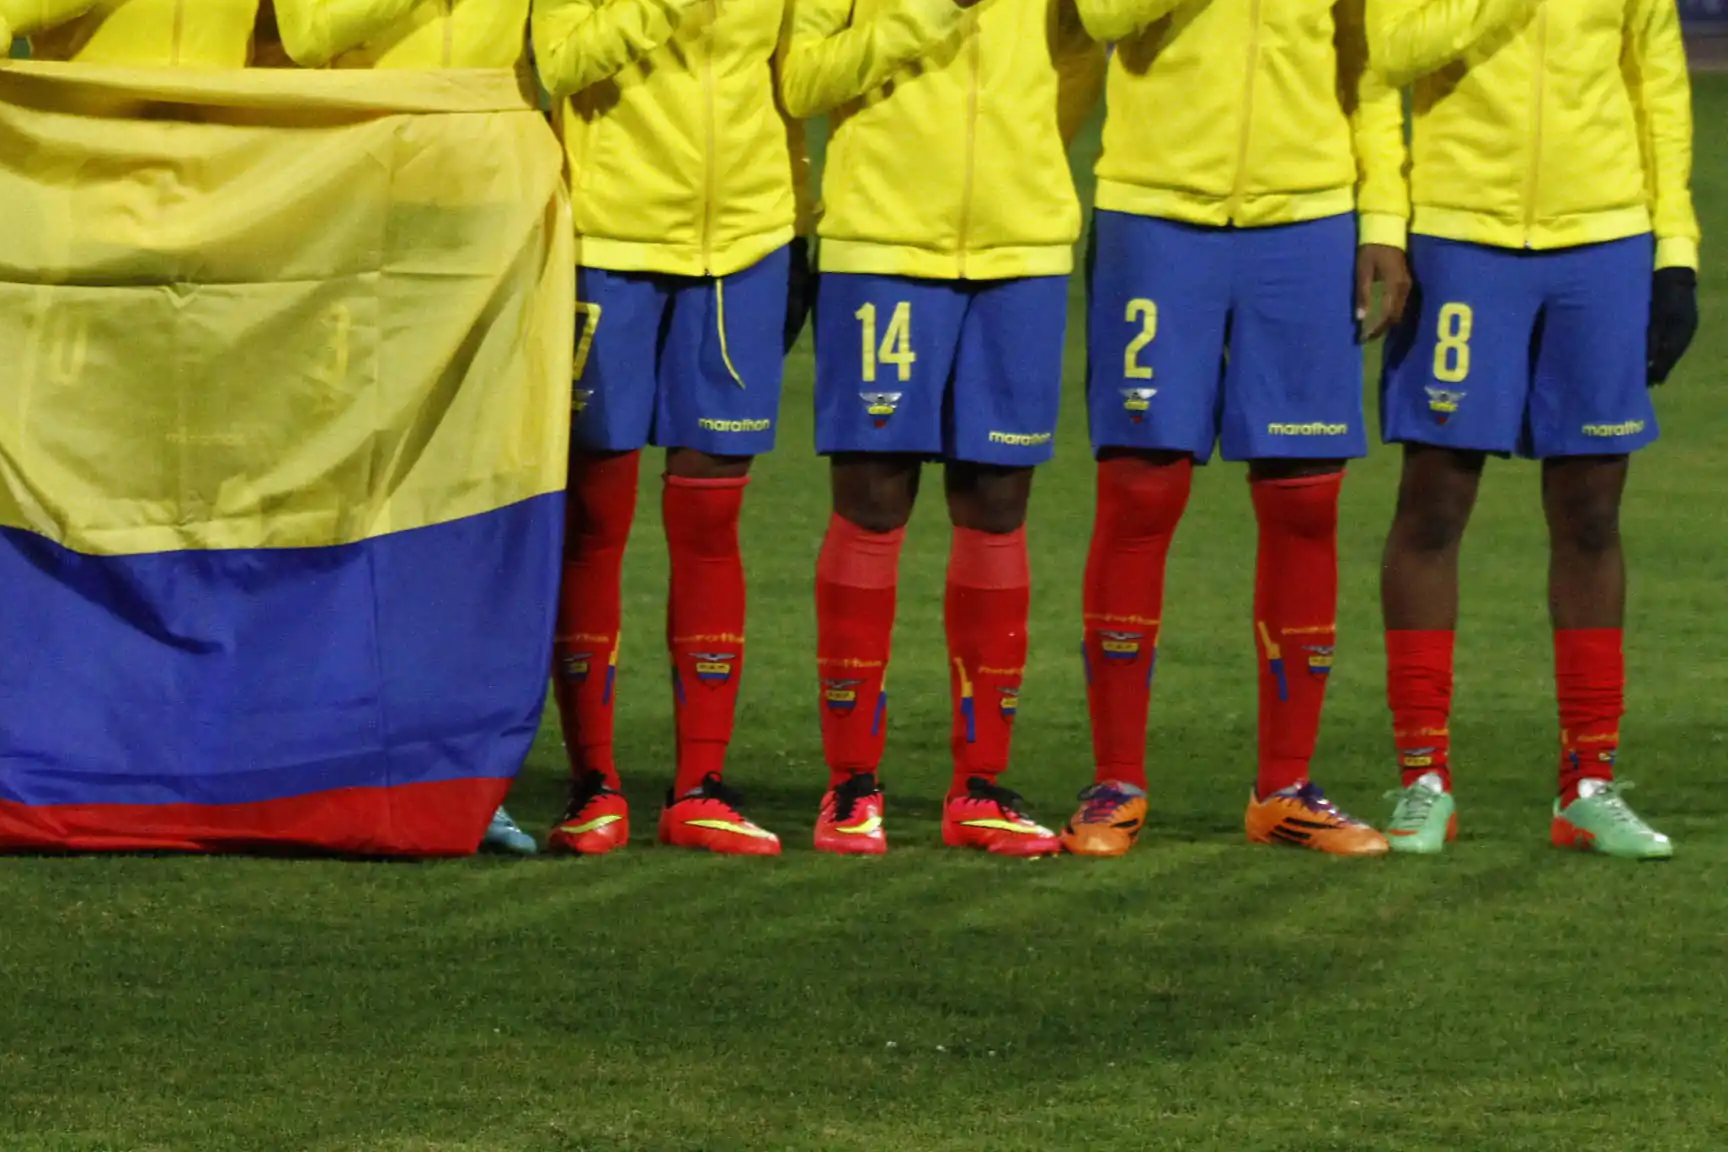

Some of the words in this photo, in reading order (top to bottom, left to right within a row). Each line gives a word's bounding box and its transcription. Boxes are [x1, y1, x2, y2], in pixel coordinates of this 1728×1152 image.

[855, 301, 916, 382] 14
[1123, 298, 1157, 379] 2
[1432, 302, 1472, 382] 8
[698, 417, 770, 433] marathon
[1268, 421, 1348, 436] marathon
